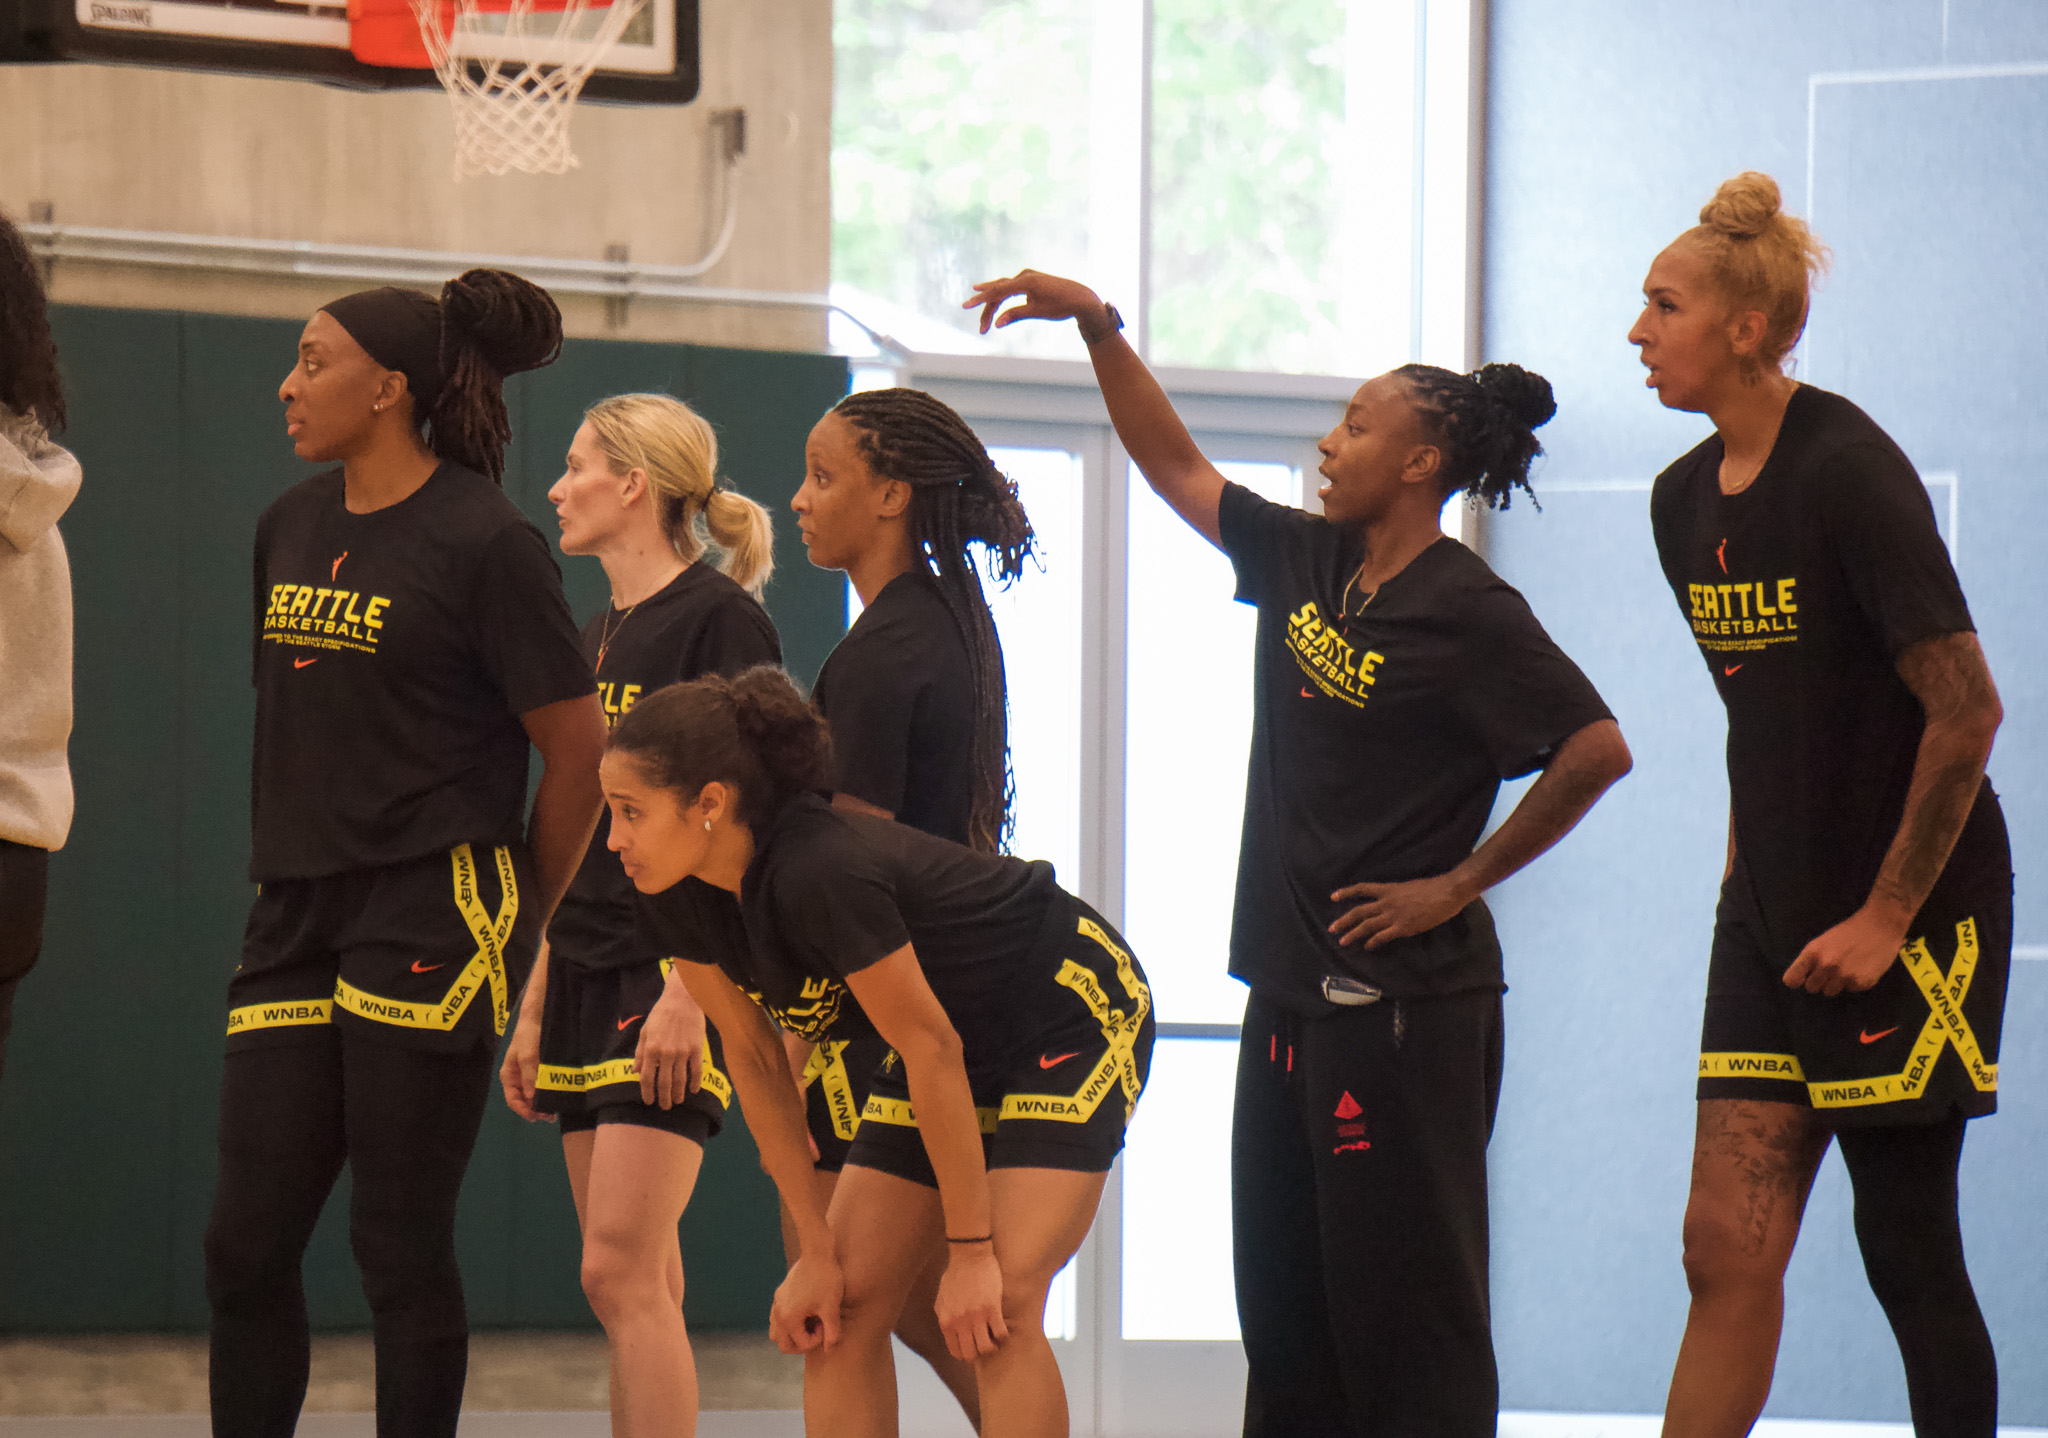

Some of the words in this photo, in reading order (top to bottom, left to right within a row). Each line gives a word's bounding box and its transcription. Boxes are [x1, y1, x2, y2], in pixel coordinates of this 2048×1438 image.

[267, 584, 391, 629] SEATTLE
[1689, 578, 1798, 619] SEATTLE
[264, 615, 379, 643] BASKETBALL
[1289, 601, 1385, 686] SEATTLE
[1288, 622, 1369, 699] BASKETBALL
[458, 855, 473, 908] WNBA
[479, 925, 502, 983] WNBA
[263, 1006, 324, 1022] WNBA
[359, 998, 415, 1021] WNBA
[1930, 983, 1965, 1042] WNBA
[1728, 1059, 1794, 1074] WNBA
[1016, 1101, 1080, 1115] WNBA
[1822, 1087, 1876, 1102] WNBA
